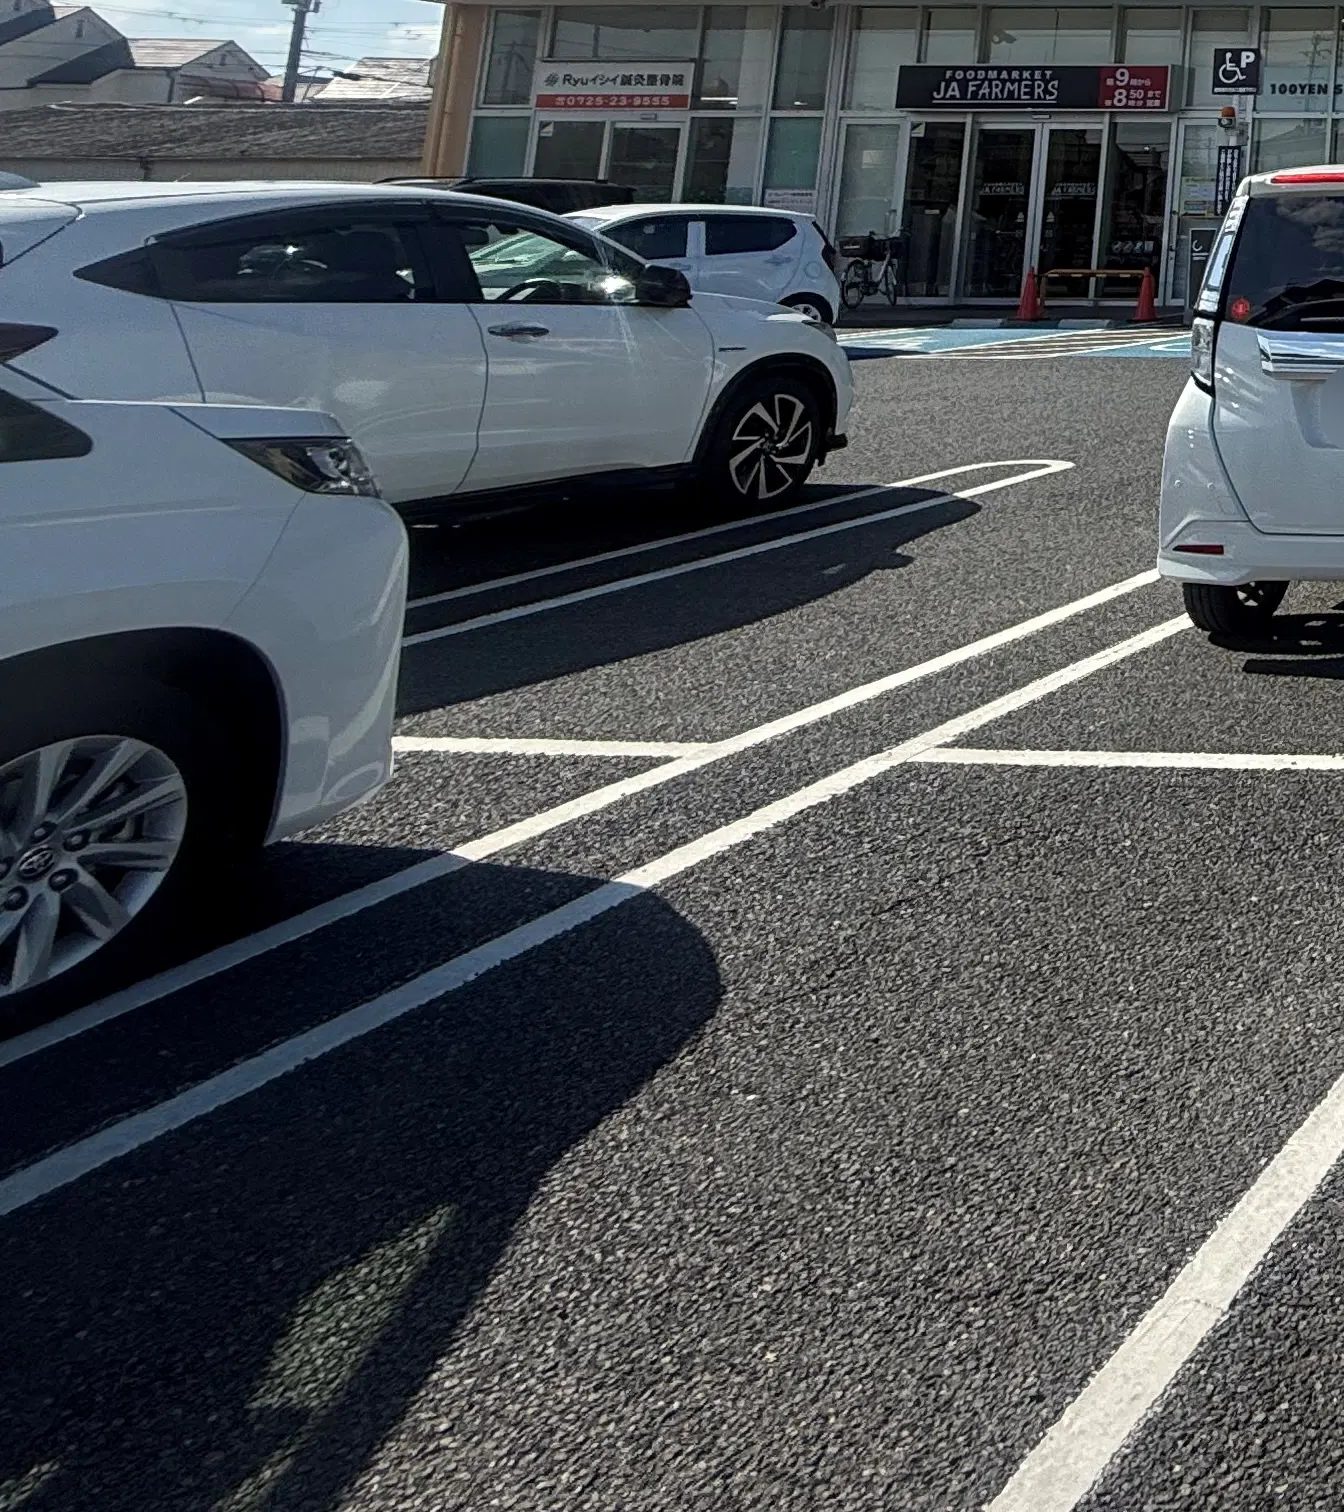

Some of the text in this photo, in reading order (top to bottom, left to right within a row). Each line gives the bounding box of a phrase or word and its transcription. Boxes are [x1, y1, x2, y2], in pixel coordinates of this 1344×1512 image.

[945, 70, 1053, 80] FOODMARKET
[932, 80, 1059, 100] JA FARMERS
[1269, 83, 1329, 96] 100YEN
